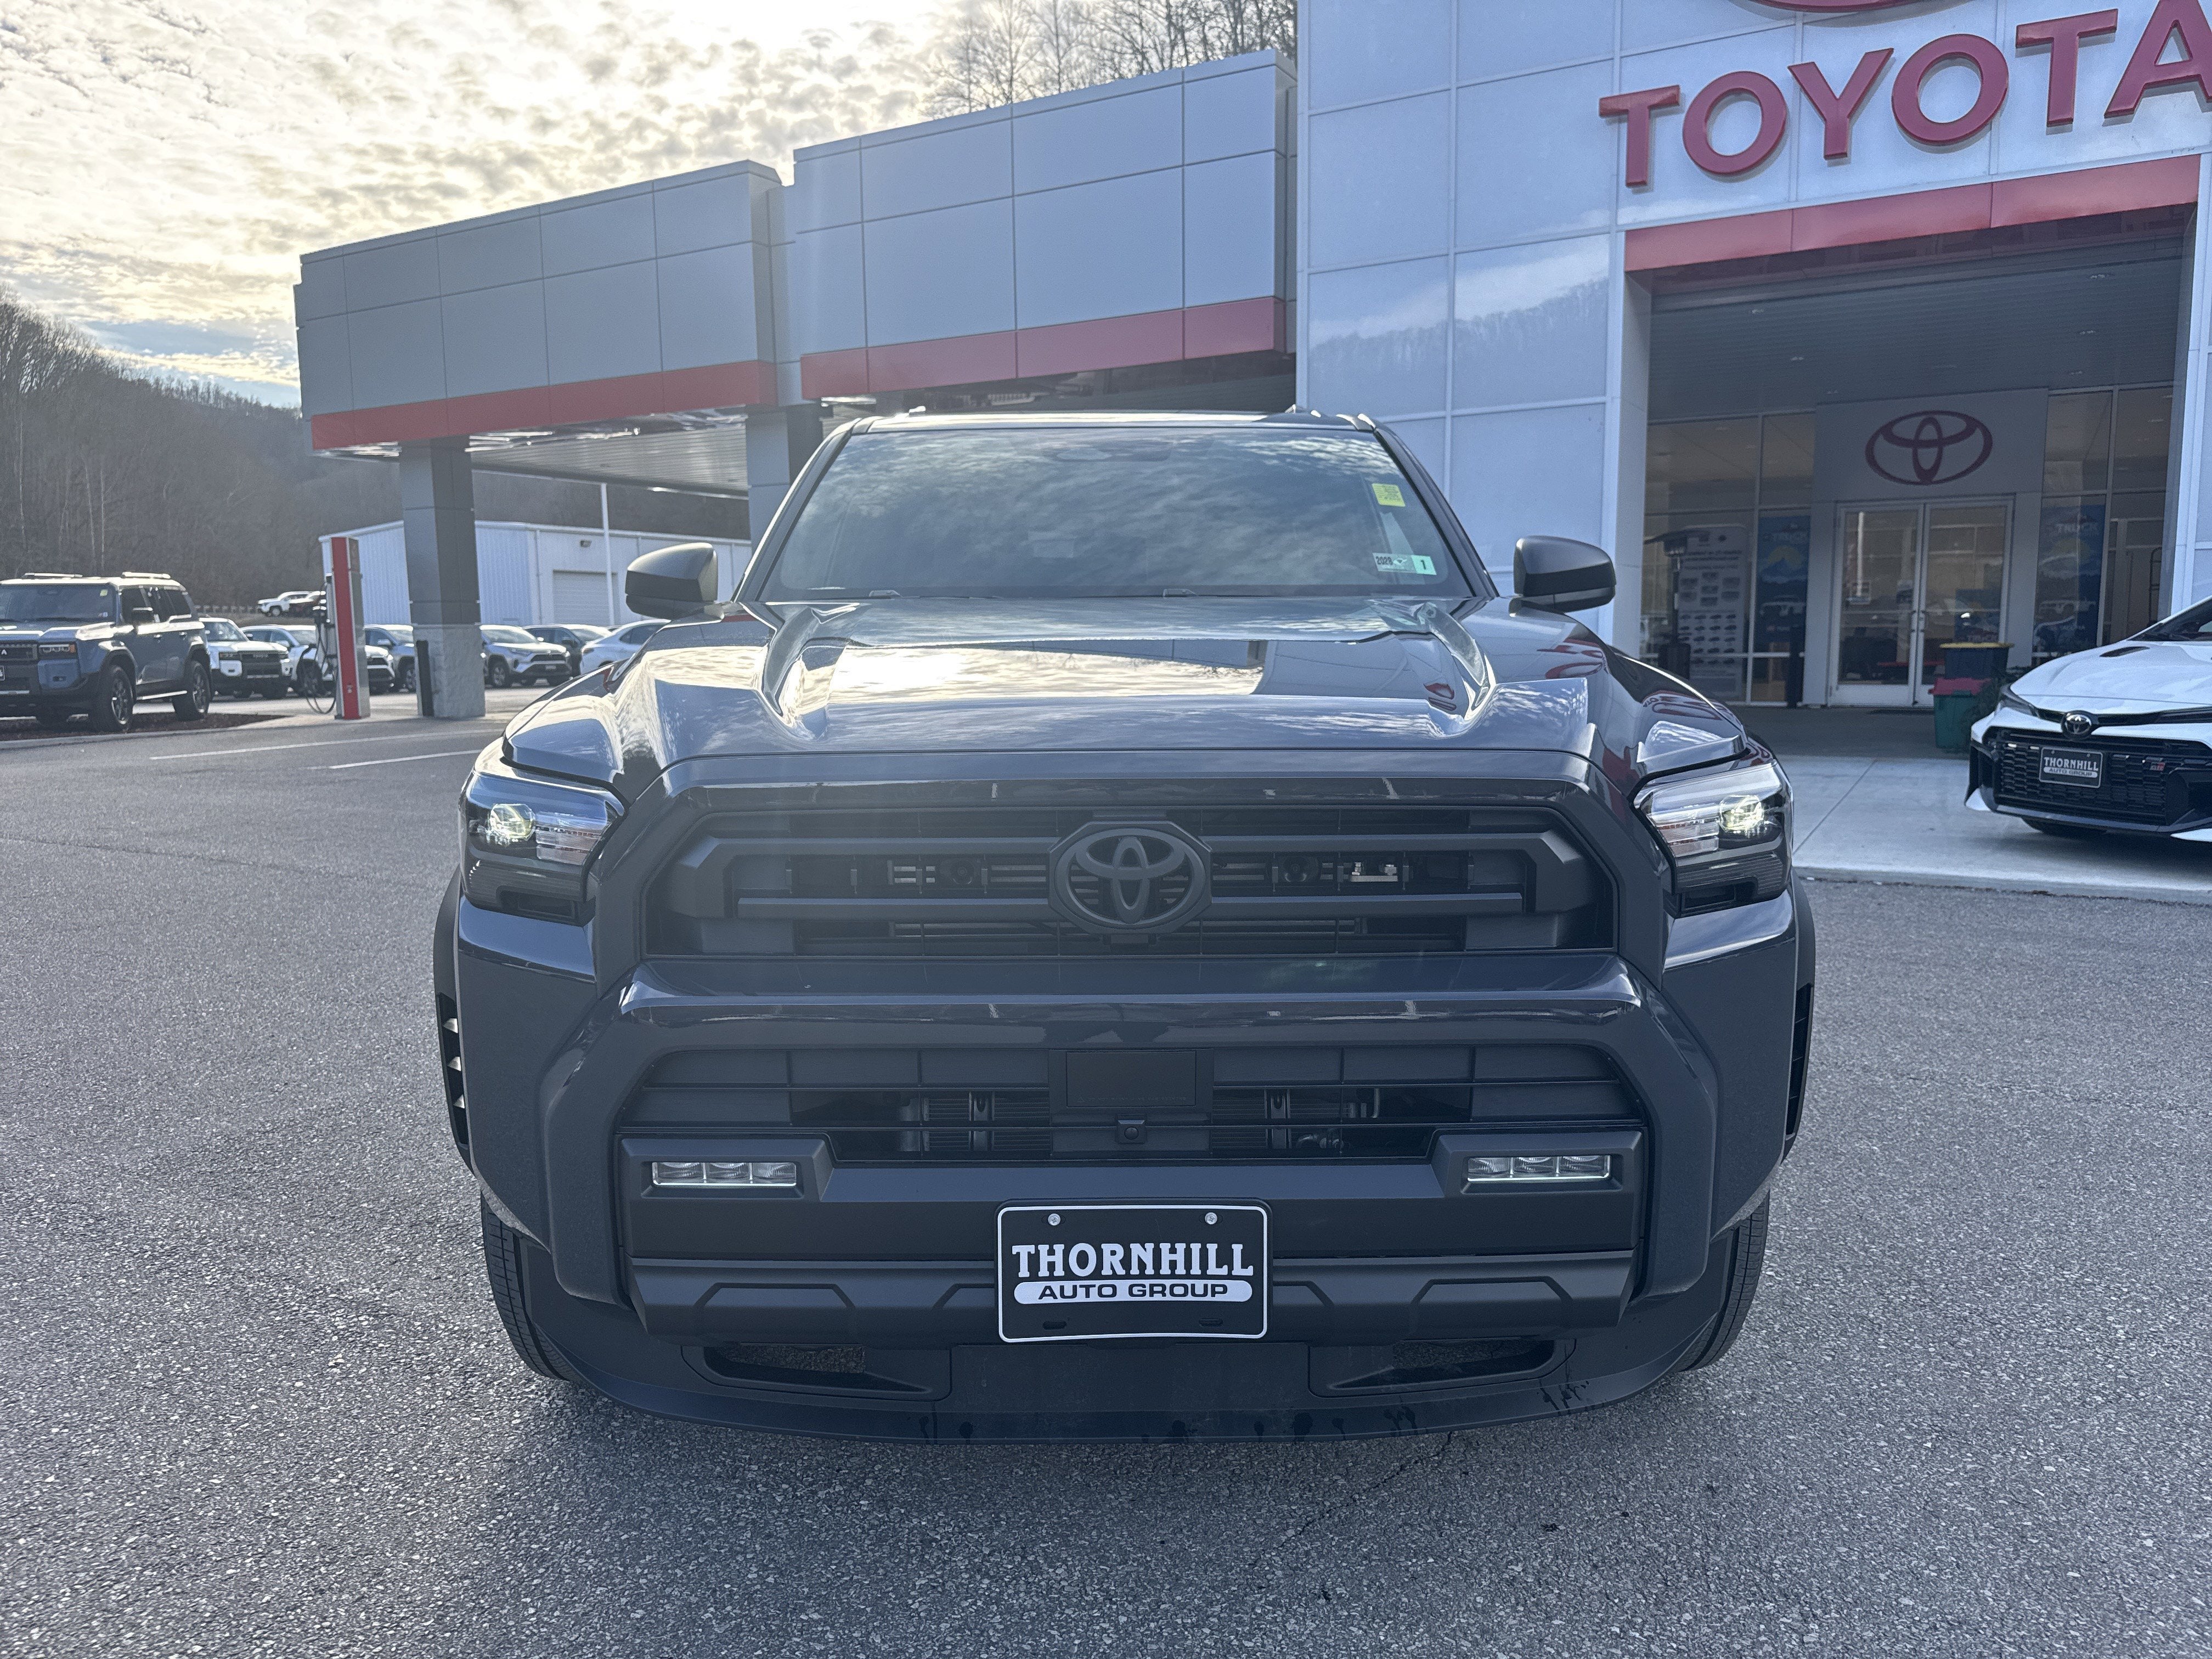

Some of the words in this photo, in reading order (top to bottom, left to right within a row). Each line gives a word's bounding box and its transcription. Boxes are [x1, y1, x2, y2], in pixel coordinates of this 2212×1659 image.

[1599, 0, 2212, 189] TOYOTA
[2044, 757, 2099, 771] THORNHILL
[1012, 1243, 1254, 1278] THORNHILL
[1038, 1284, 1118, 1300] AUTO
[1128, 1283, 1228, 1298] GROUP
